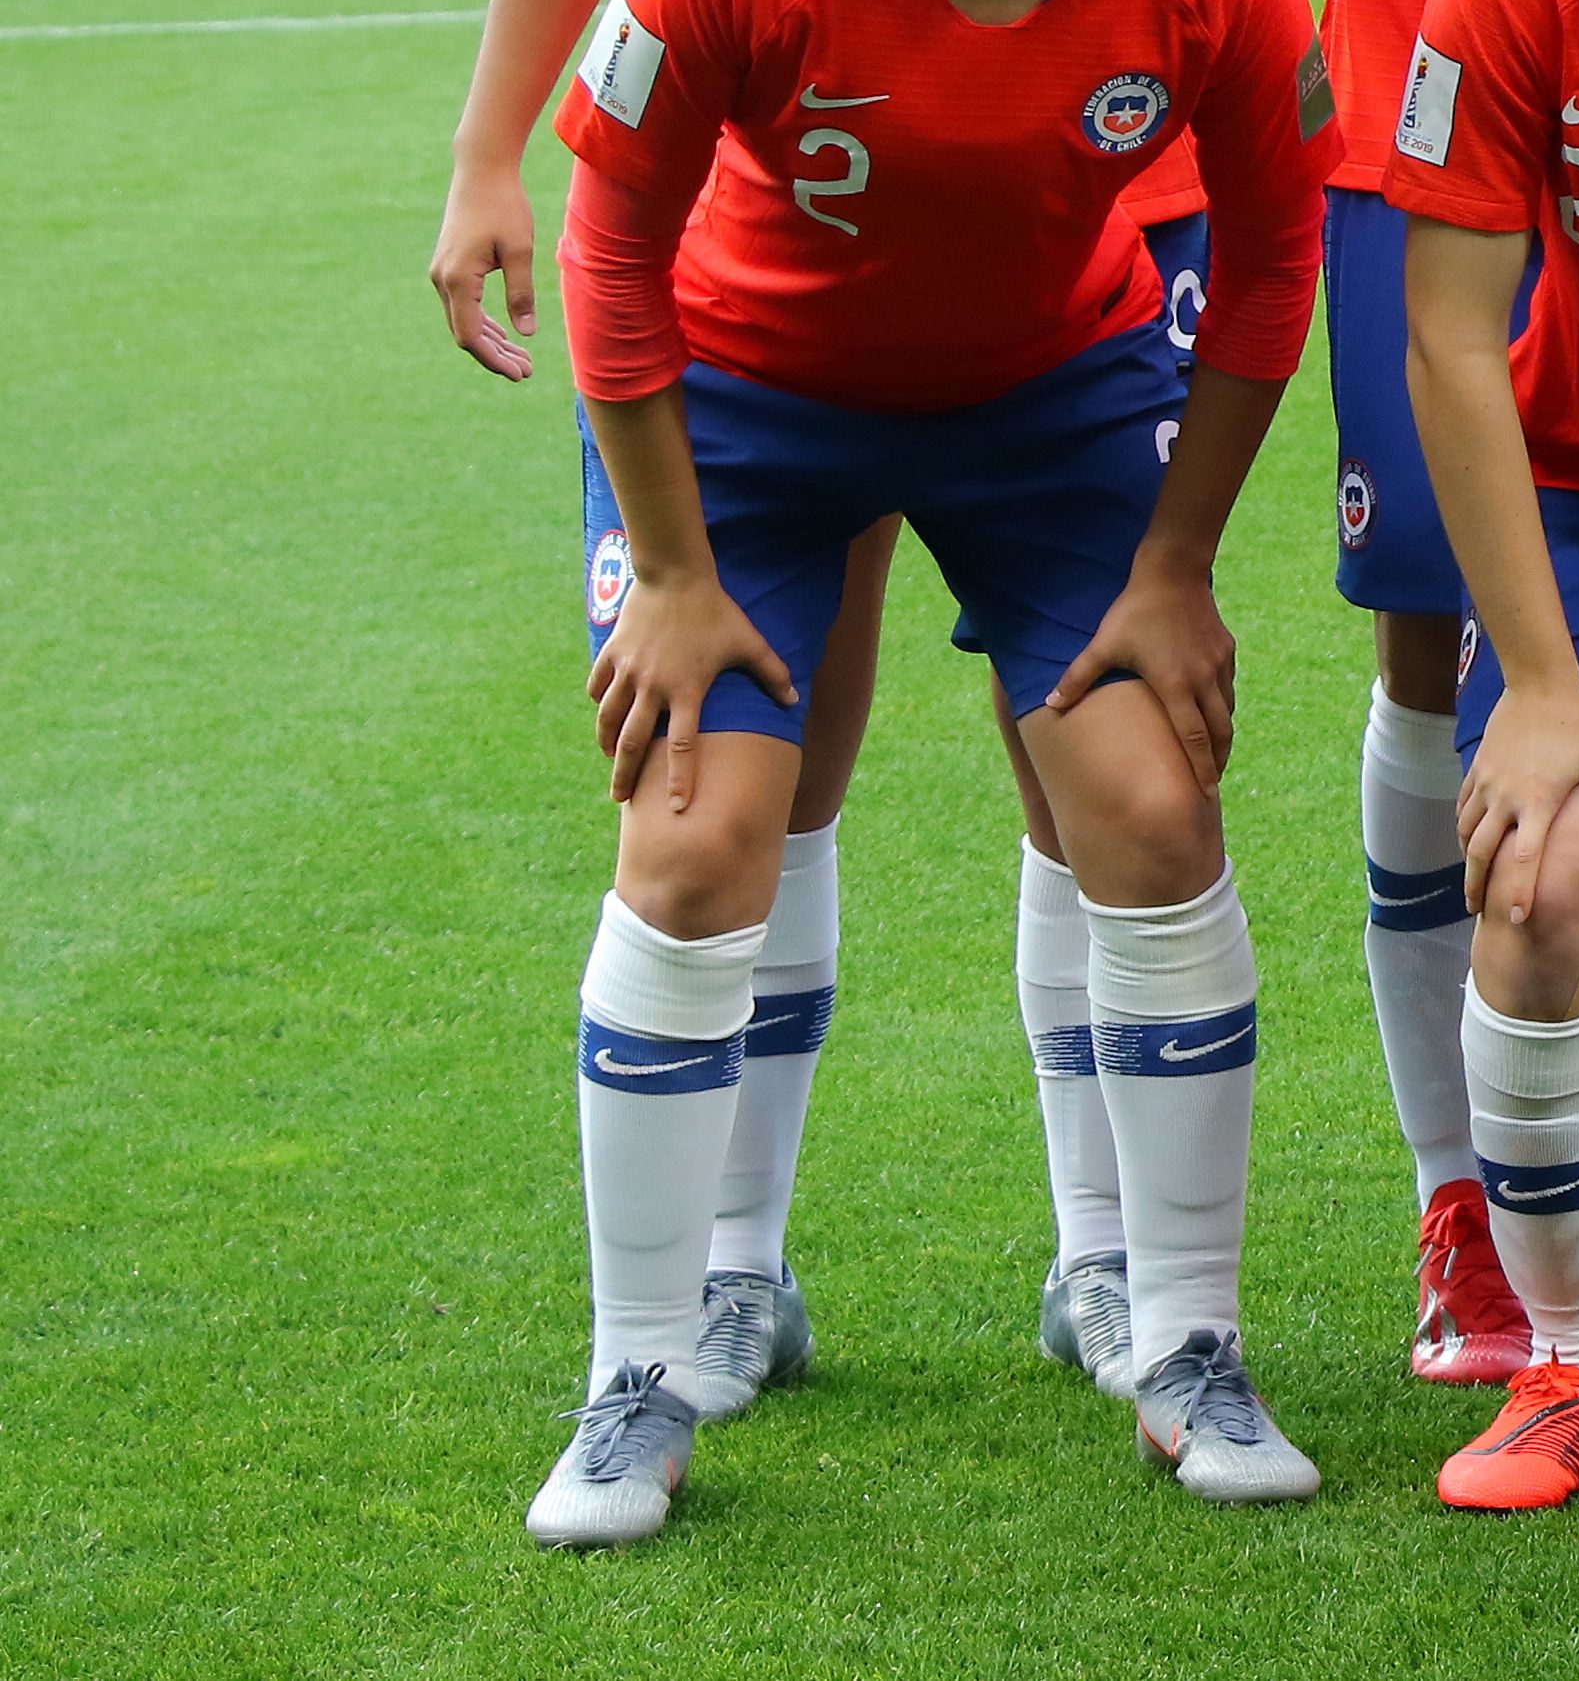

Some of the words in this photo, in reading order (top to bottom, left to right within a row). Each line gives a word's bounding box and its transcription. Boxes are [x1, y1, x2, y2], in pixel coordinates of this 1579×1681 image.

[1083, 75, 1132, 116] FEDERACION
[1137, 75, 1152, 85] DE
[1100, 139, 1112, 151] DE
[1116, 135, 1143, 152] CHILE
[1411, 138, 1434, 154] 2019
[793, 129, 869, 236] 2
